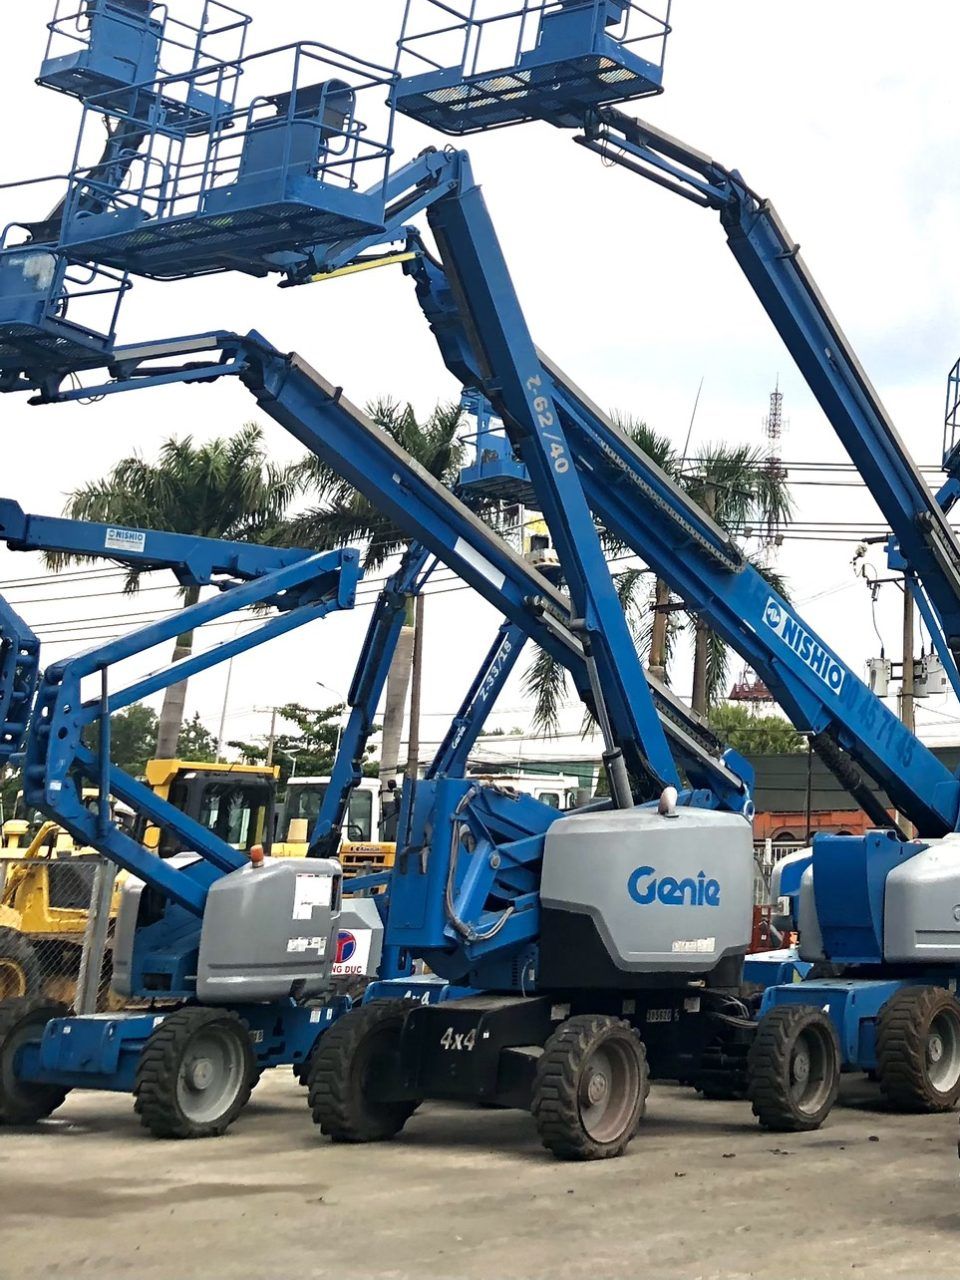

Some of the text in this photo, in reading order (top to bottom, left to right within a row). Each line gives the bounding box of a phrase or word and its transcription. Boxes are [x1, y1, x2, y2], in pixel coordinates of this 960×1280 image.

[526, 374, 569, 474] Z-62/40
[116, 530, 144, 541] NISHIO
[781, 617, 843, 690] NISHIO
[627, 865, 721, 907] Genie
[344, 965, 362, 974] DUC
[440, 1026, 477, 1051] 4x4
